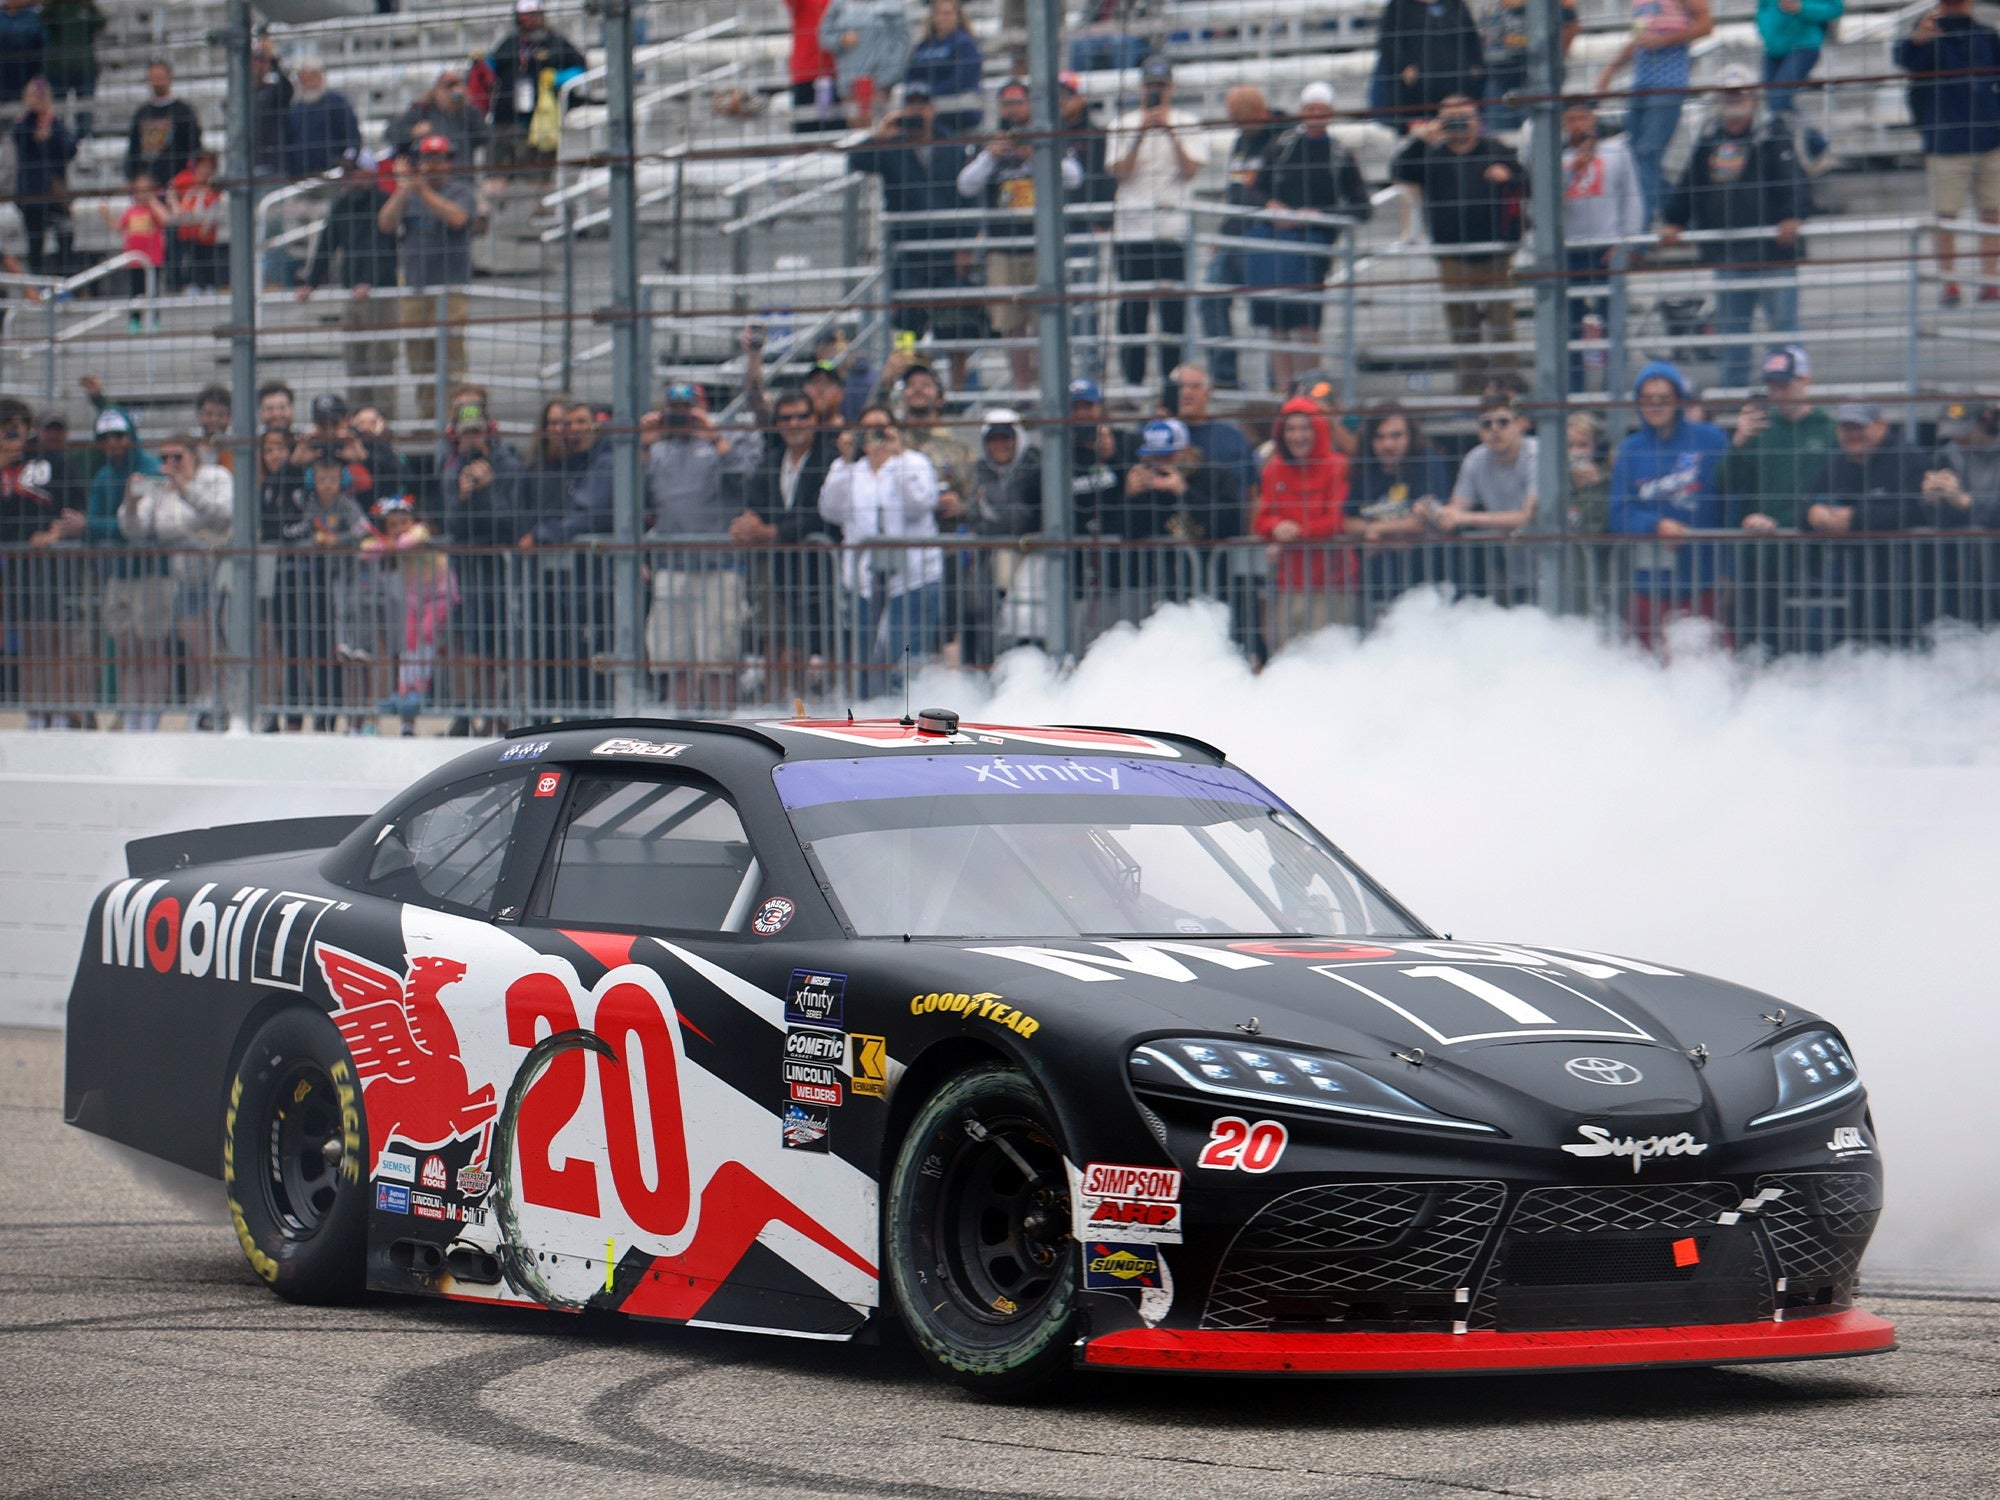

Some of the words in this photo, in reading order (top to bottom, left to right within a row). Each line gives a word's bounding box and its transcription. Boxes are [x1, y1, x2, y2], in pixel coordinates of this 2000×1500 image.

[965, 757, 1120, 791] xfinity
[764, 900, 792, 915] NASCAR
[102, 877, 269, 982] Mobil
[794, 985, 835, 1016] xfinity
[805, 1009, 823, 1020] SERIES
[786, 1034, 844, 1059] COMETIC
[786, 1064, 832, 1086] LINCOLN
[504, 971, 691, 1236] 20
[796, 1085, 837, 1102] WELDERS
[331, 1059, 360, 1185] EAGLE
[1197, 1115, 1289, 1174] 20
[1561, 1124, 1709, 1174] Supra
[1826, 1126, 1868, 1150] JGR
[382, 1159, 411, 1174] SIEMENS
[422, 1157, 446, 1181] MAG
[422, 1178, 447, 1190] TOOLS
[1089, 1167, 1175, 1198] SIMPSON
[412, 1194, 440, 1208] LINCOLN
[417, 1205, 442, 1219] WELDERS
[1089, 1200, 1178, 1226] ARP
[446, 1202, 476, 1225] Mobil
[1093, 1259, 1155, 1273] SUNOCO
